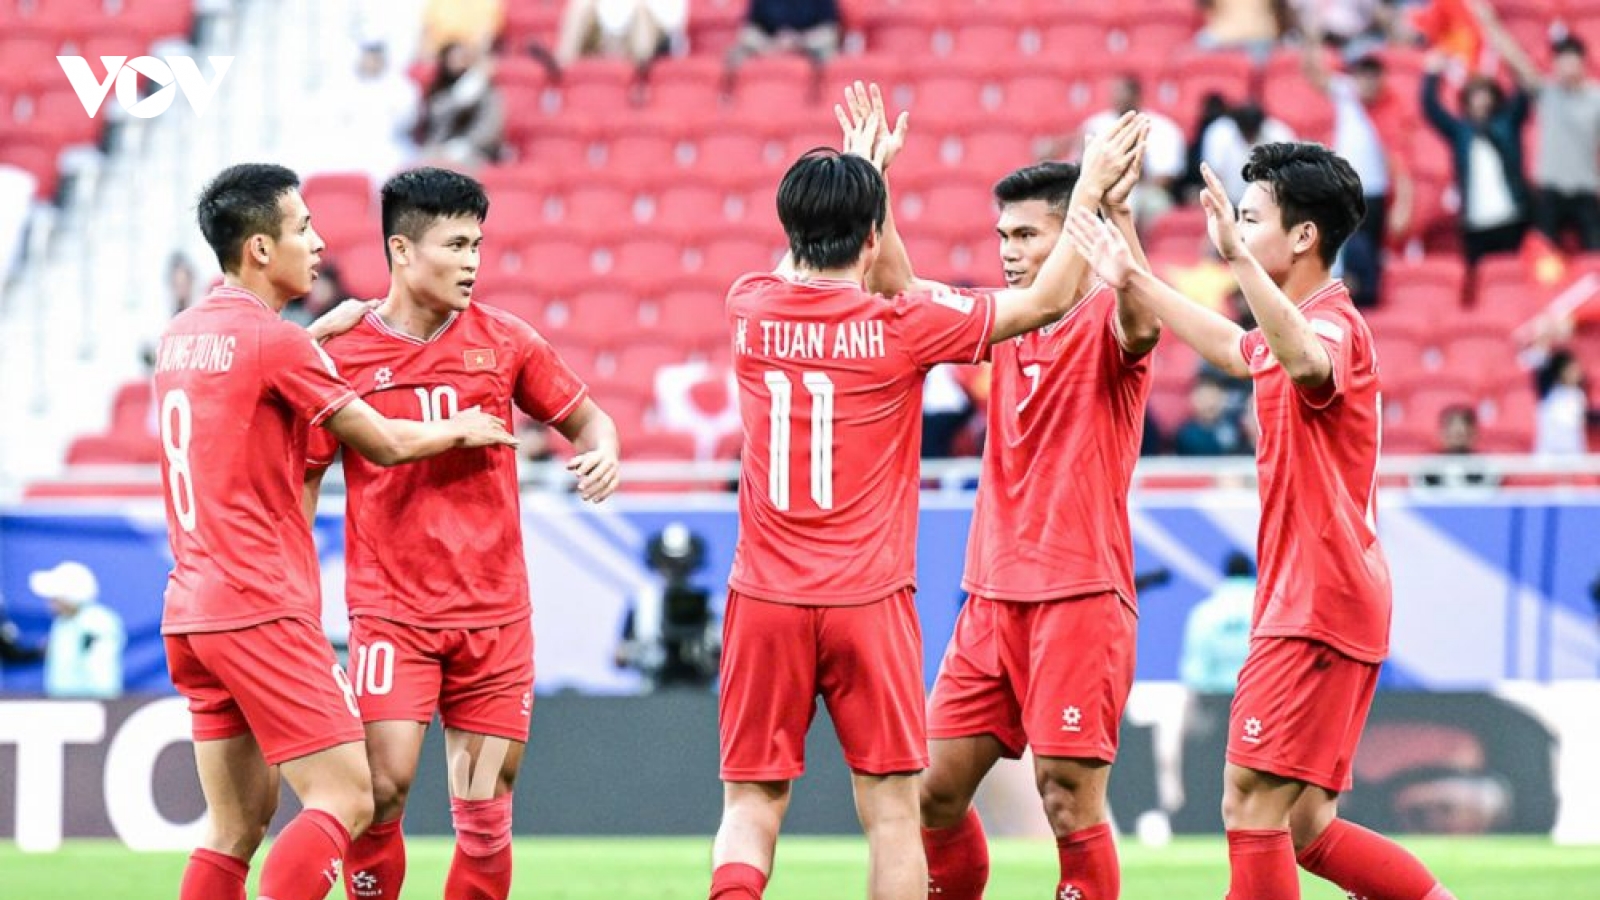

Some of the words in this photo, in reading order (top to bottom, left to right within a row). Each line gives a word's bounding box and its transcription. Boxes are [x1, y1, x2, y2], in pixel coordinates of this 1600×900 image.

[760, 319, 825, 359] TUAN
[832, 319, 885, 359] ANH
[414, 385, 457, 422] 10
[162, 388, 195, 532] 8
[764, 371, 834, 511] 11
[332, 663, 360, 718] 8
[356, 641, 394, 697] 10
